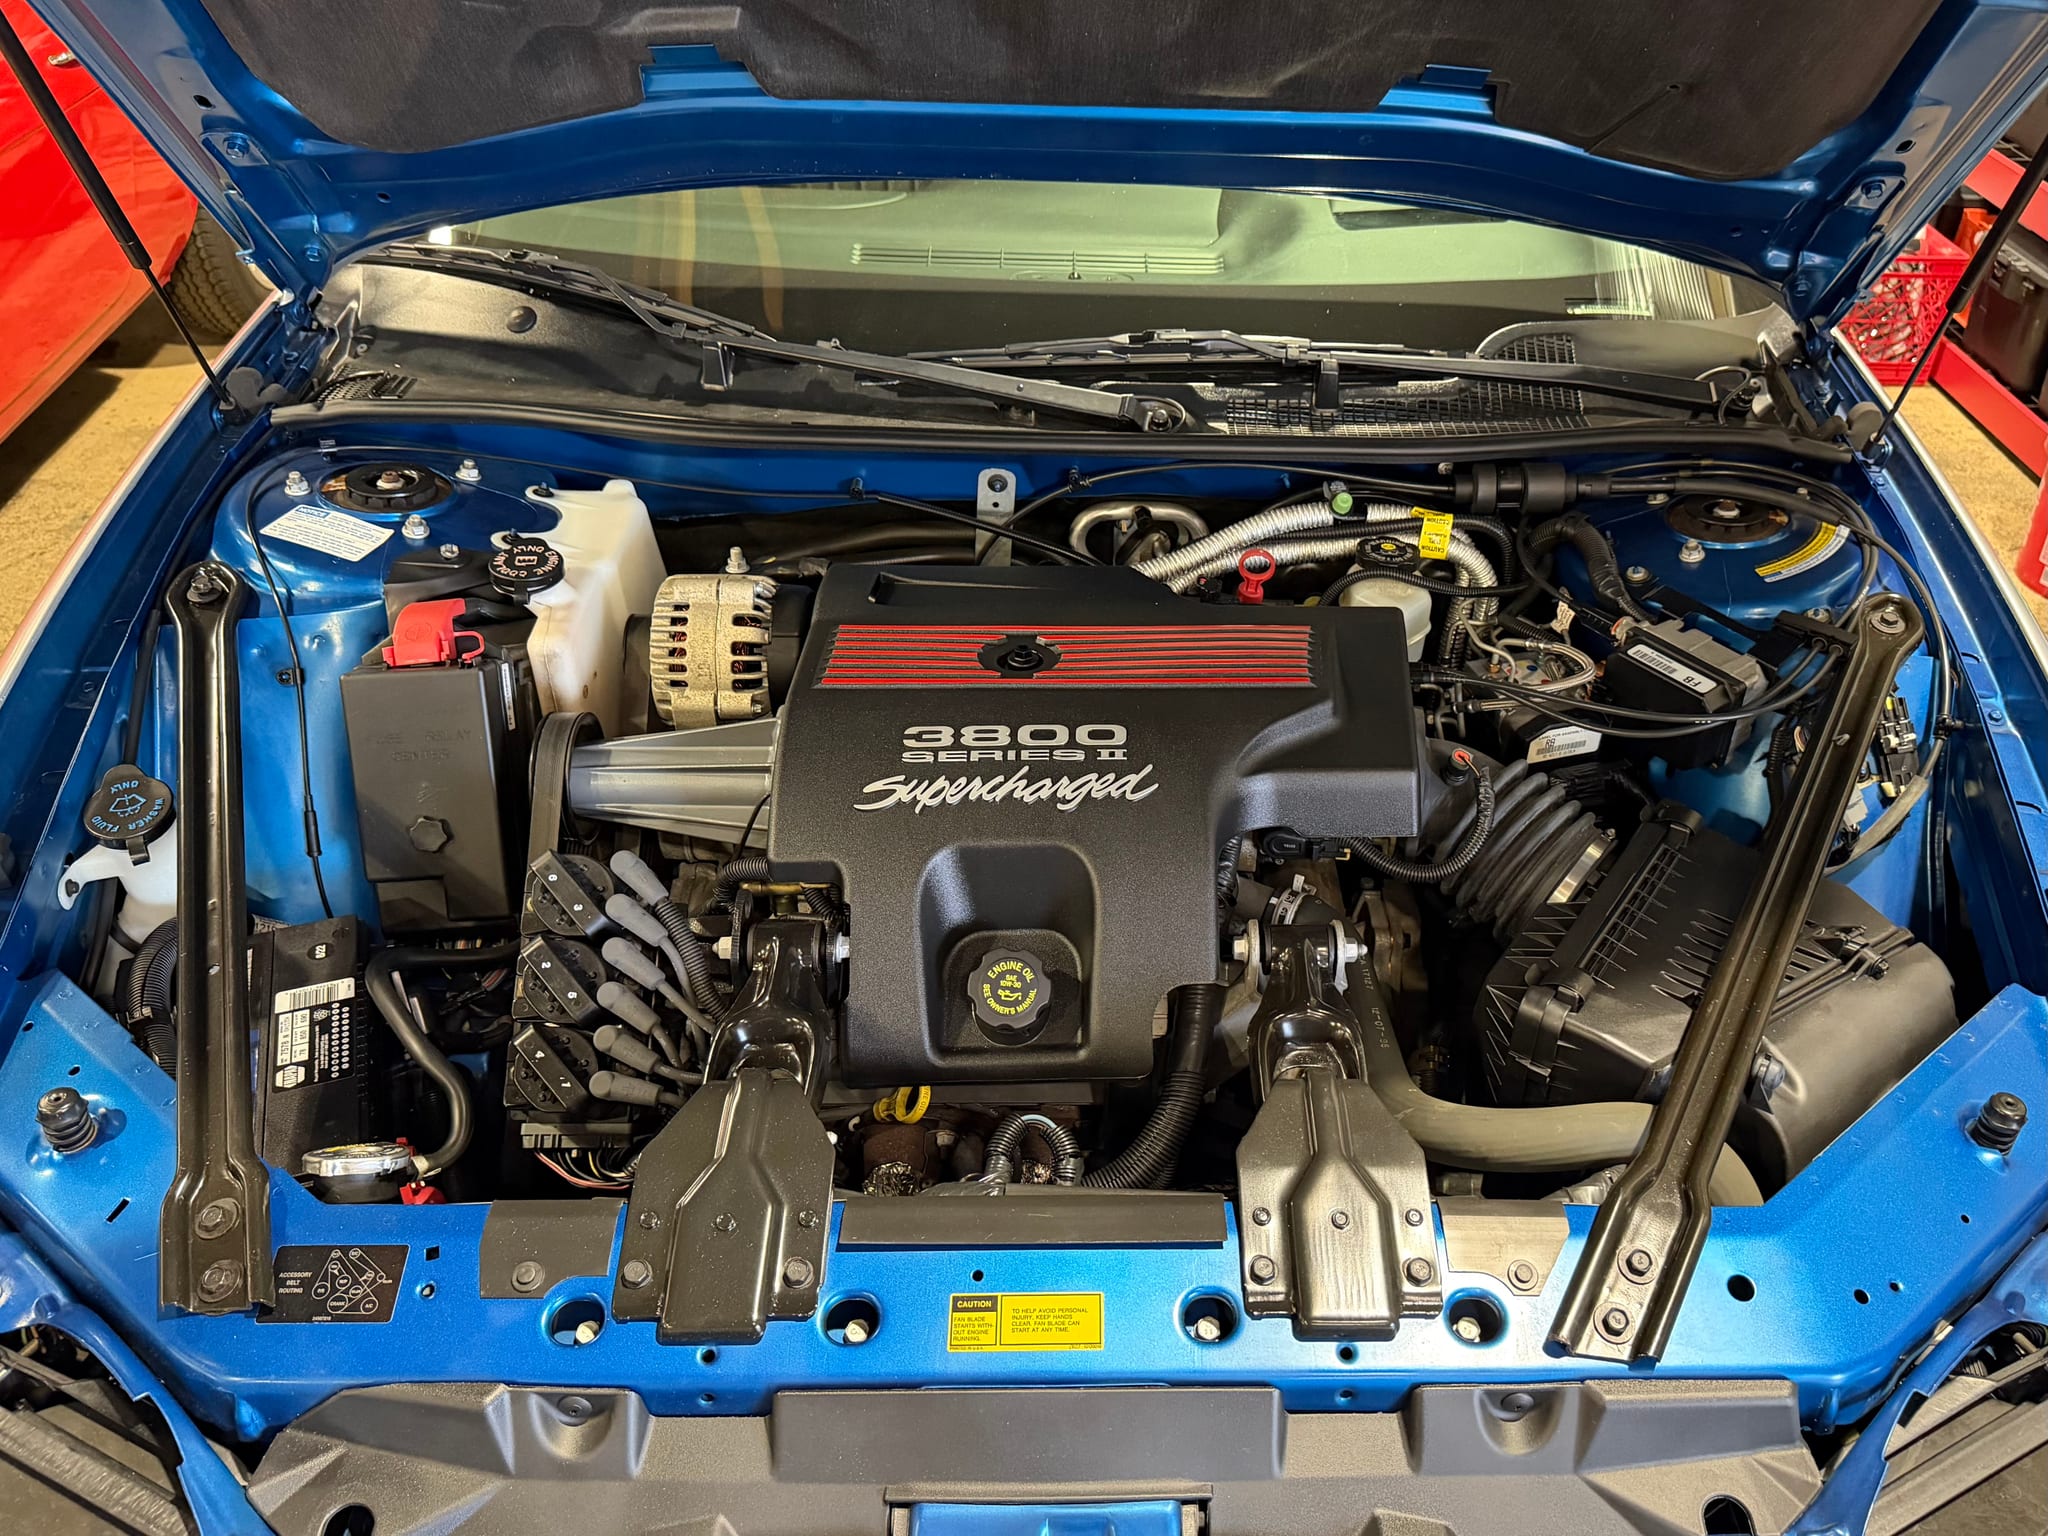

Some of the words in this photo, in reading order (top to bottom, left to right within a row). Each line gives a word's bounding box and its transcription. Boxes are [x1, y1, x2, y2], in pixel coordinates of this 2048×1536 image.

[299, 507, 326, 517] NOTICE
[513, 545, 545, 554] ONLY
[903, 724, 1127, 748] 3800
[901, 749, 1085, 764] SERIES
[1096, 748, 1128, 760] II
[110, 780, 139, 794] ONLY
[853, 763, 1159, 814] Supercharged
[128, 798, 164, 830] WASHER
[91, 815, 120, 832] FLUID
[573, 903, 583, 911] 3
[541, 961, 551, 969] 2
[987, 960, 1024, 979] ENGINE
[1022, 967, 1036, 983] OIL
[983, 983, 991, 998] SEE
[1000, 980, 1022, 988] 10W-30
[986, 997, 1016, 1015] OWNER'S
[1016, 988, 1037, 1013] MANUAL
[535, 1050, 545, 1058] 4
[957, 1300, 992, 1308] CAUTION
